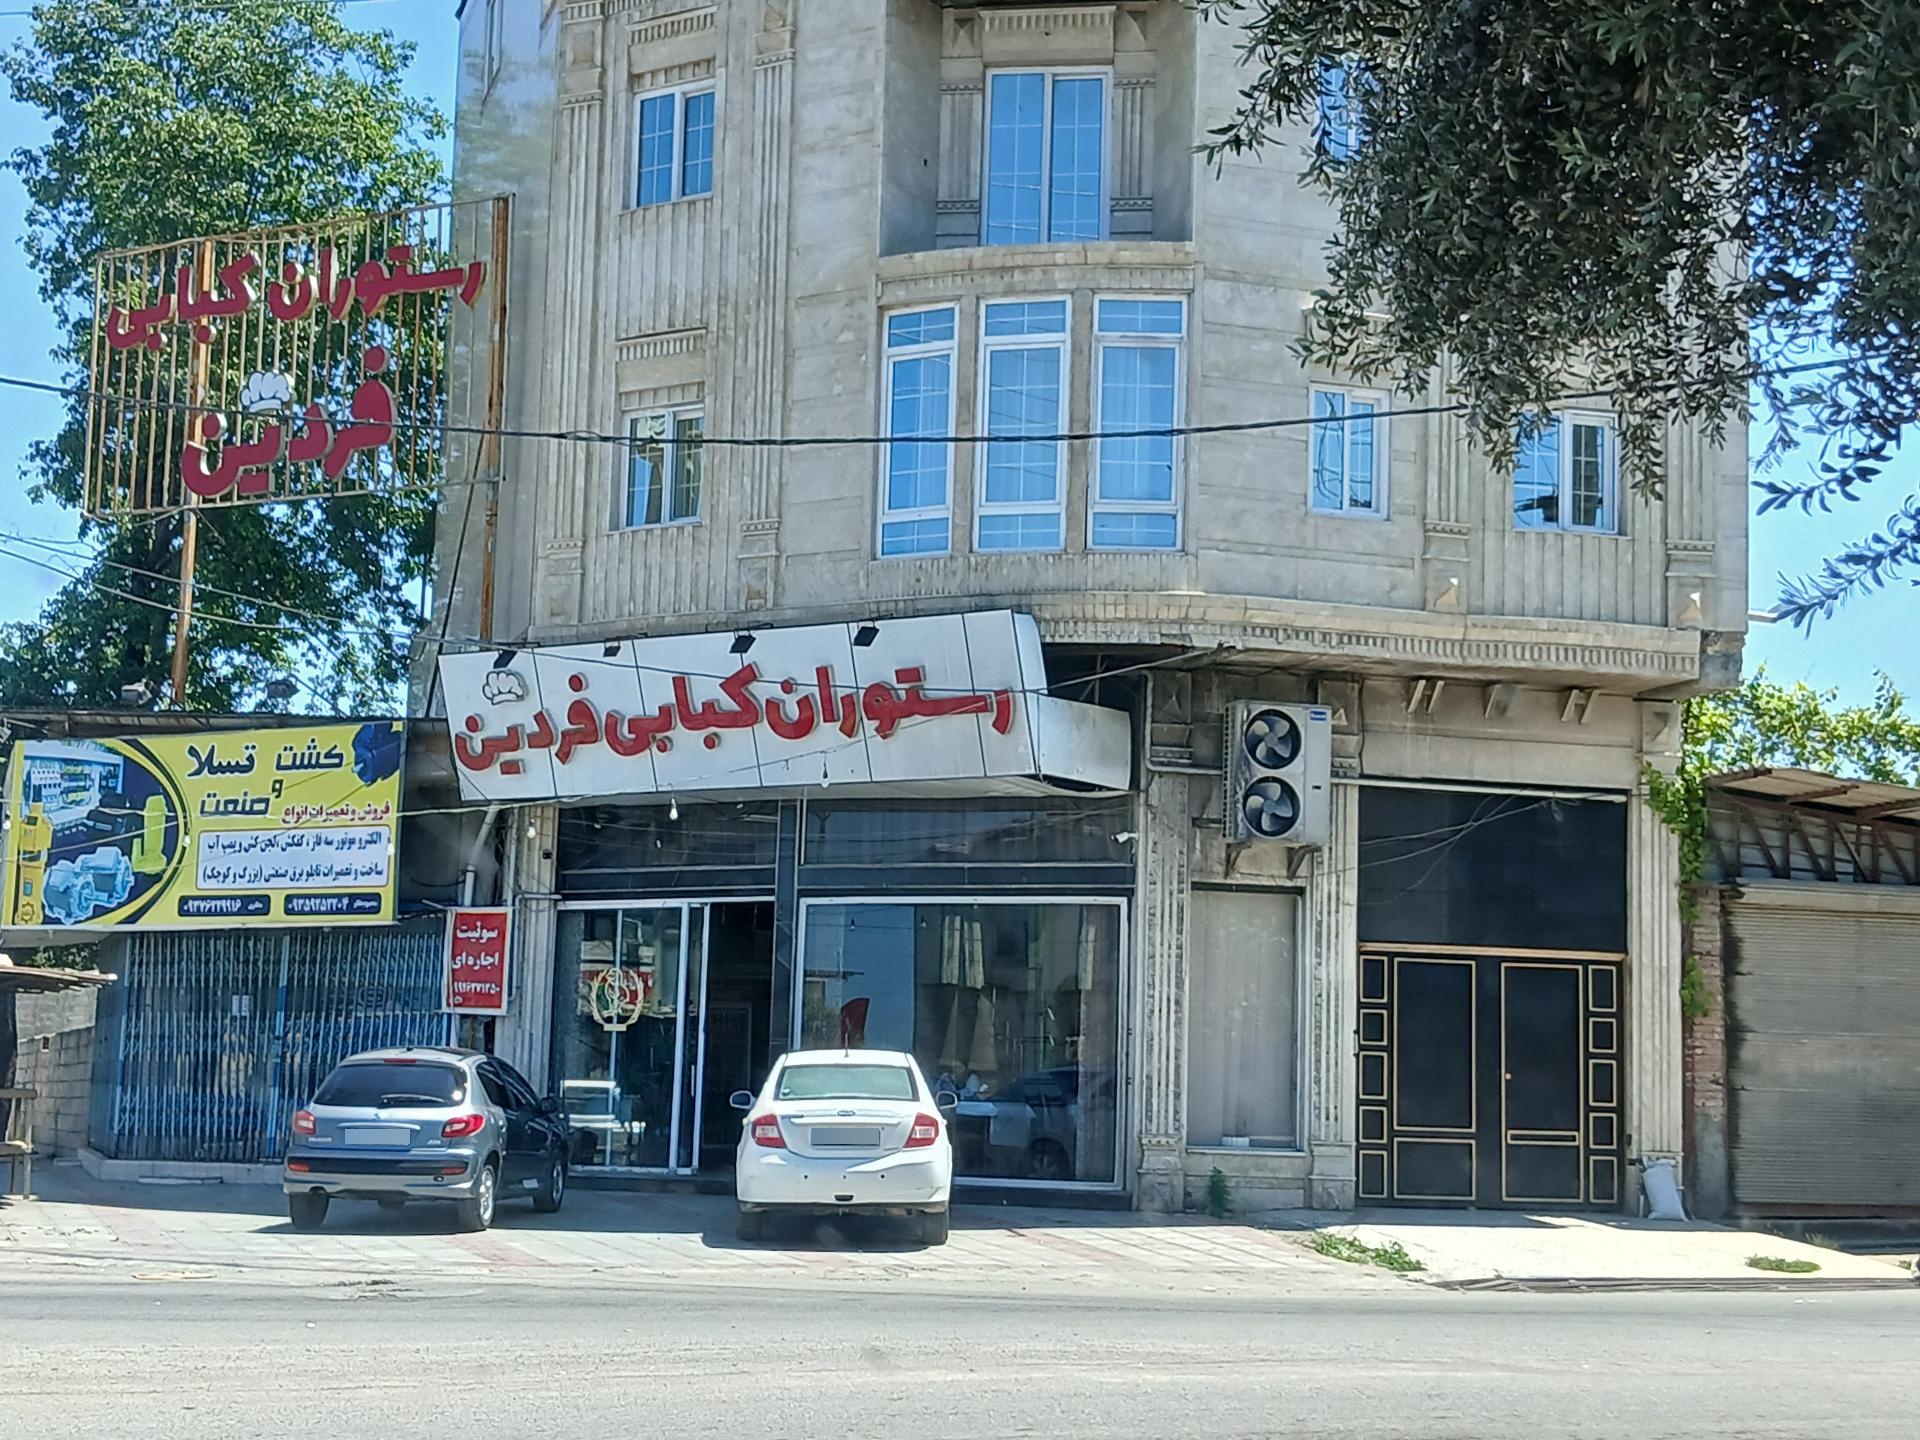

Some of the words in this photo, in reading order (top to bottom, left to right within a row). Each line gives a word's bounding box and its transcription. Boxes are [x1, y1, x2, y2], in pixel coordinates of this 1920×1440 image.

[268, 244, 483, 322] رستوران
[106, 250, 258, 350] کبابی
[181, 346, 394, 497] فردین
[605, 662, 762, 756] کبابی
[765, 664, 1013, 740] رستوران
[454, 672, 600, 775] فردین
[187, 744, 256, 777] تسلا
[275, 738, 344, 771] کشت
[271, 779, 284, 799] و
[199, 791, 271, 816] صنعت
[281, 804, 309, 824] انواع
[309, 803, 350, 823] تعمیرات
[349, 808, 357, 821] و
[358, 800, 390, 821] فروش
[335, 831, 356, 850] موتور
[322, 862, 352, 882] تعمیرات
[360, 862, 384, 877] ساخت
